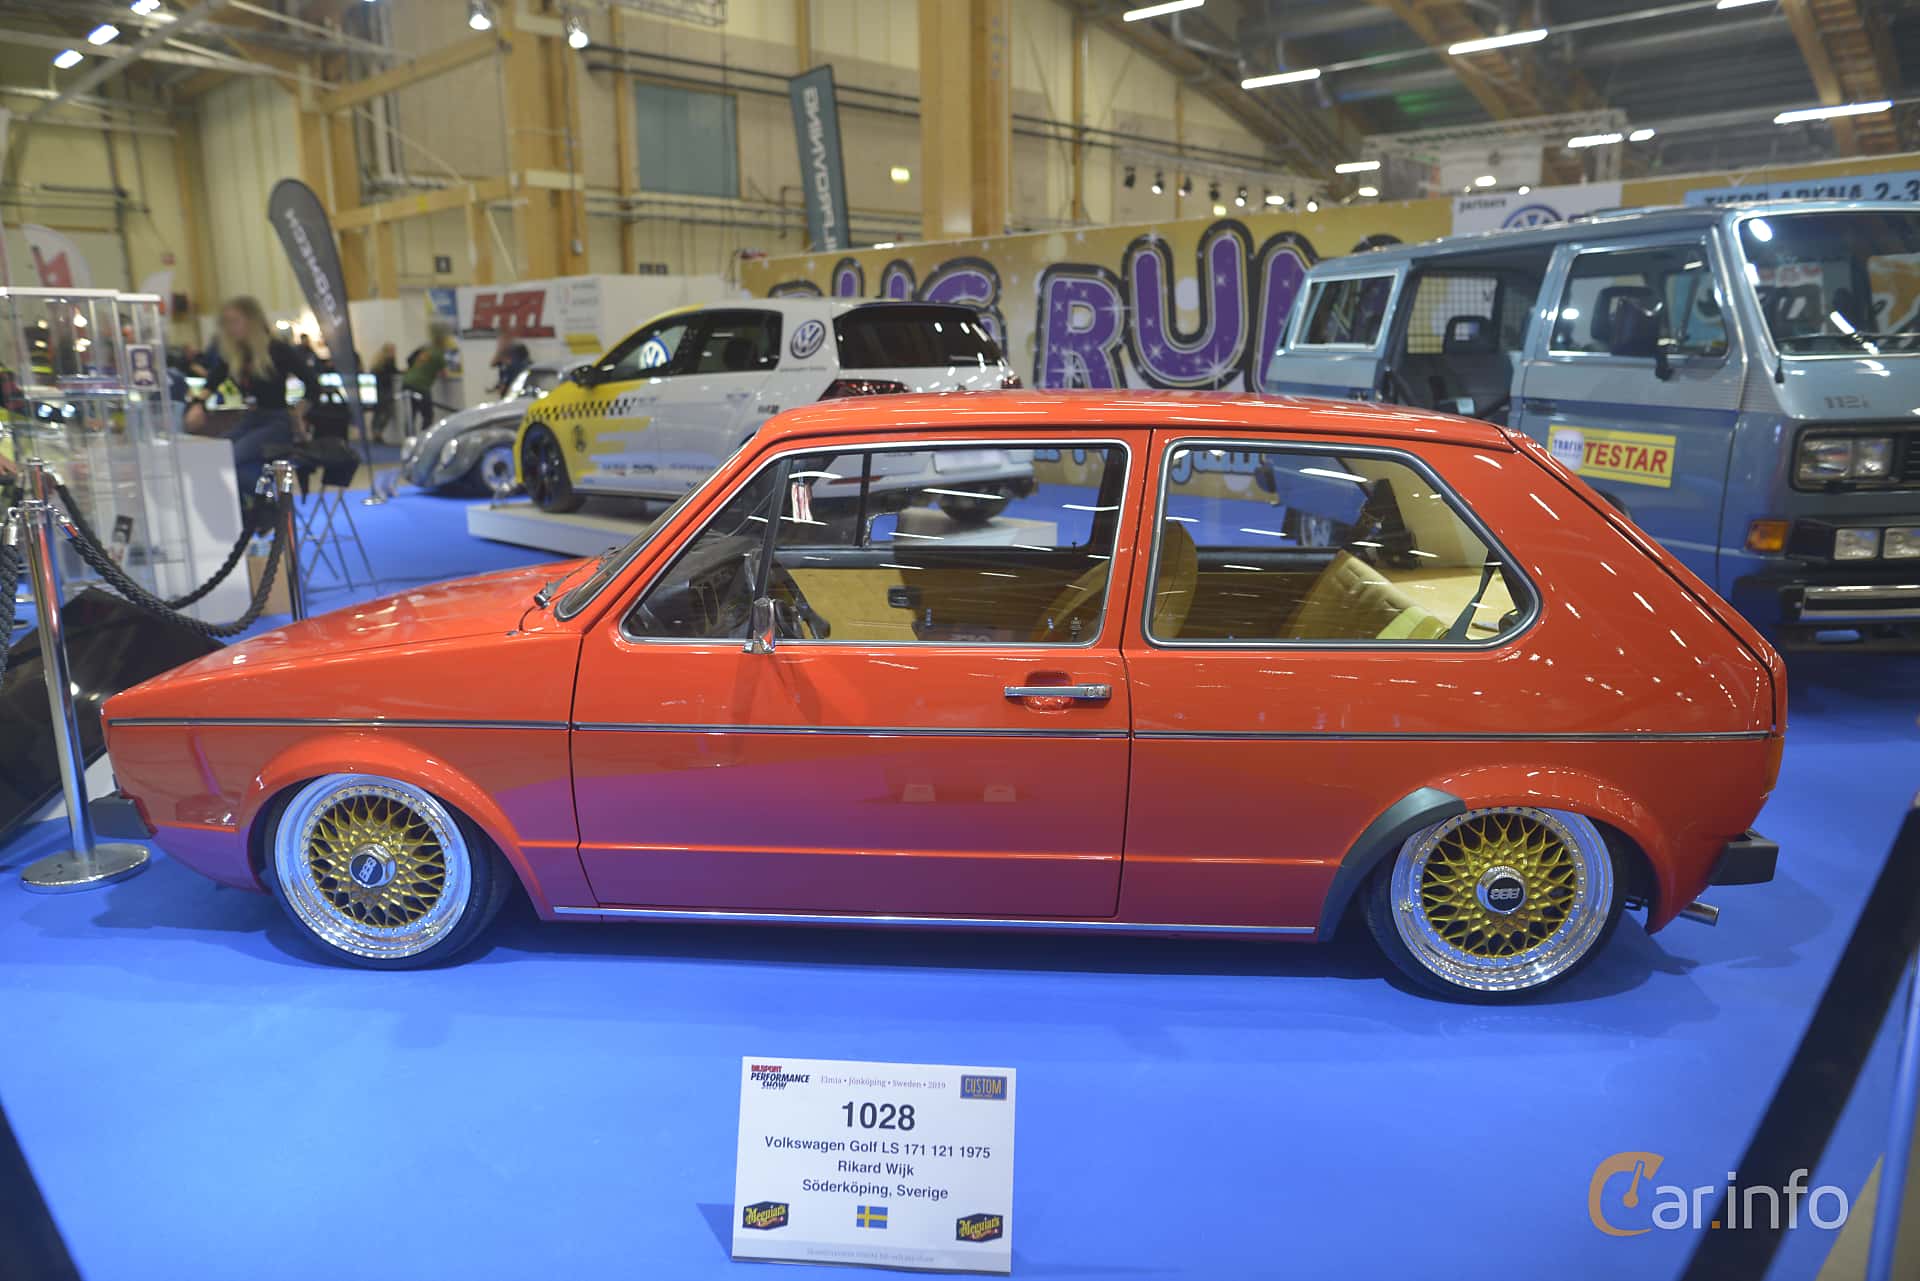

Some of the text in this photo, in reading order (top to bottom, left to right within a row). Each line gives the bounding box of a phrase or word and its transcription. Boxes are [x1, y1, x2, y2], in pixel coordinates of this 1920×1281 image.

[1585, 441, 1668, 474] TESTAR
[359, 857, 377, 882] BBS
[750, 1072, 810, 1083] PERFORMANCE
[761, 1081, 787, 1090] SHOW
[965, 1078, 1002, 1095] CUSTOM
[842, 1101, 915, 1131] 1028
[765, 1136, 991, 1158] Volkswagen Golf LS 171 121 1975
[838, 1160, 914, 1178] Rikard Wijk
[802, 1179, 949, 1201] Söderköping, Sverige
